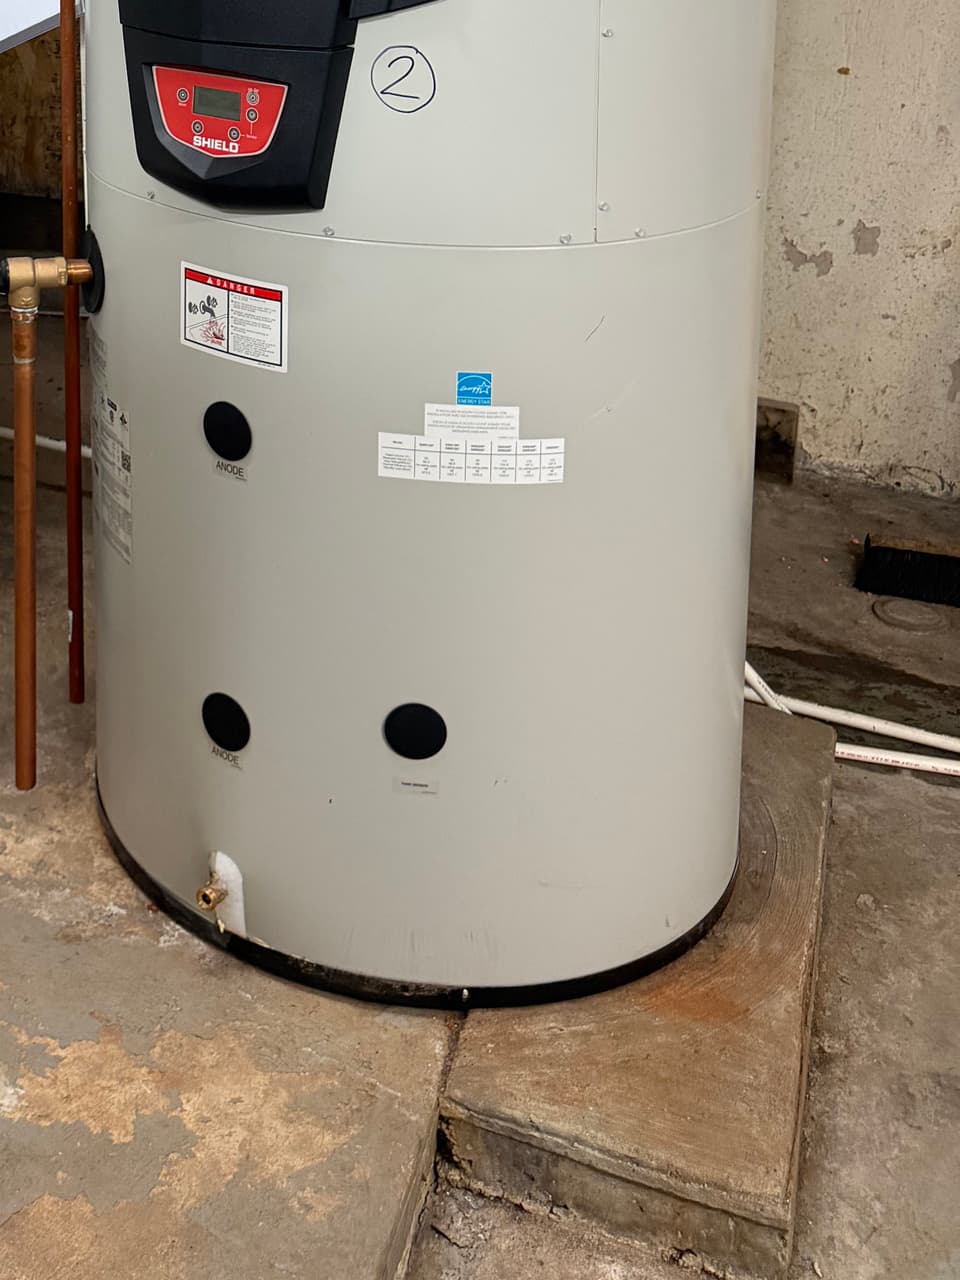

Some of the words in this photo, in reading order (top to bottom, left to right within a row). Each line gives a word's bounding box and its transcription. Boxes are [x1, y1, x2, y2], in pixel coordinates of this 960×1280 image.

[380, 55, 420, 99] 2
[192, 135, 239, 154] SHIELD
[215, 460, 244, 477] ANODE
[211, 745, 239, 765] ANODE
